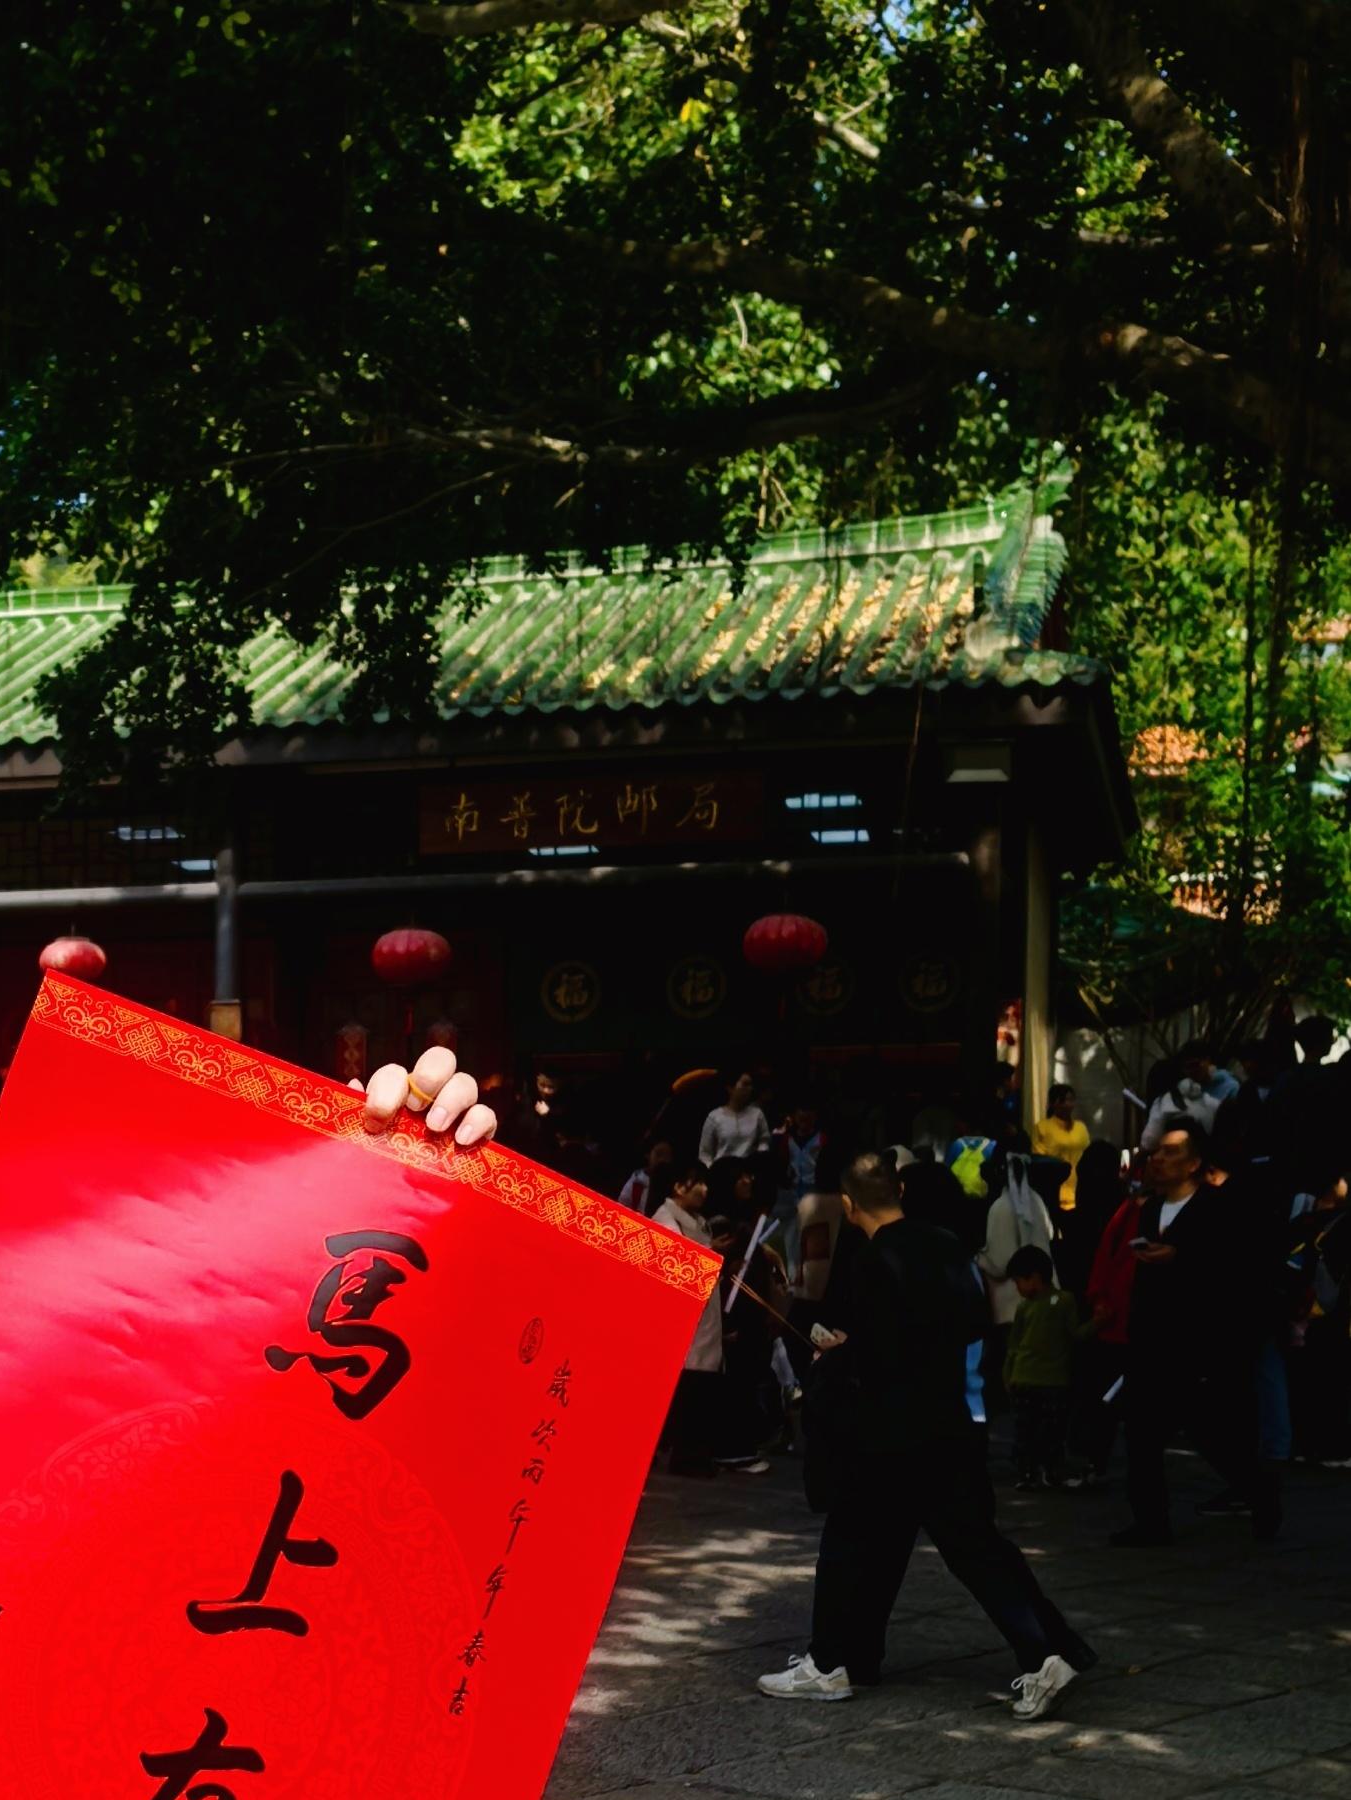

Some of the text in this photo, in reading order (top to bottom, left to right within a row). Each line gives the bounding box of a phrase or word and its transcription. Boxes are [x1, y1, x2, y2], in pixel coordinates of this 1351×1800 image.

[444, 781, 720, 842] 南普陀邮局
